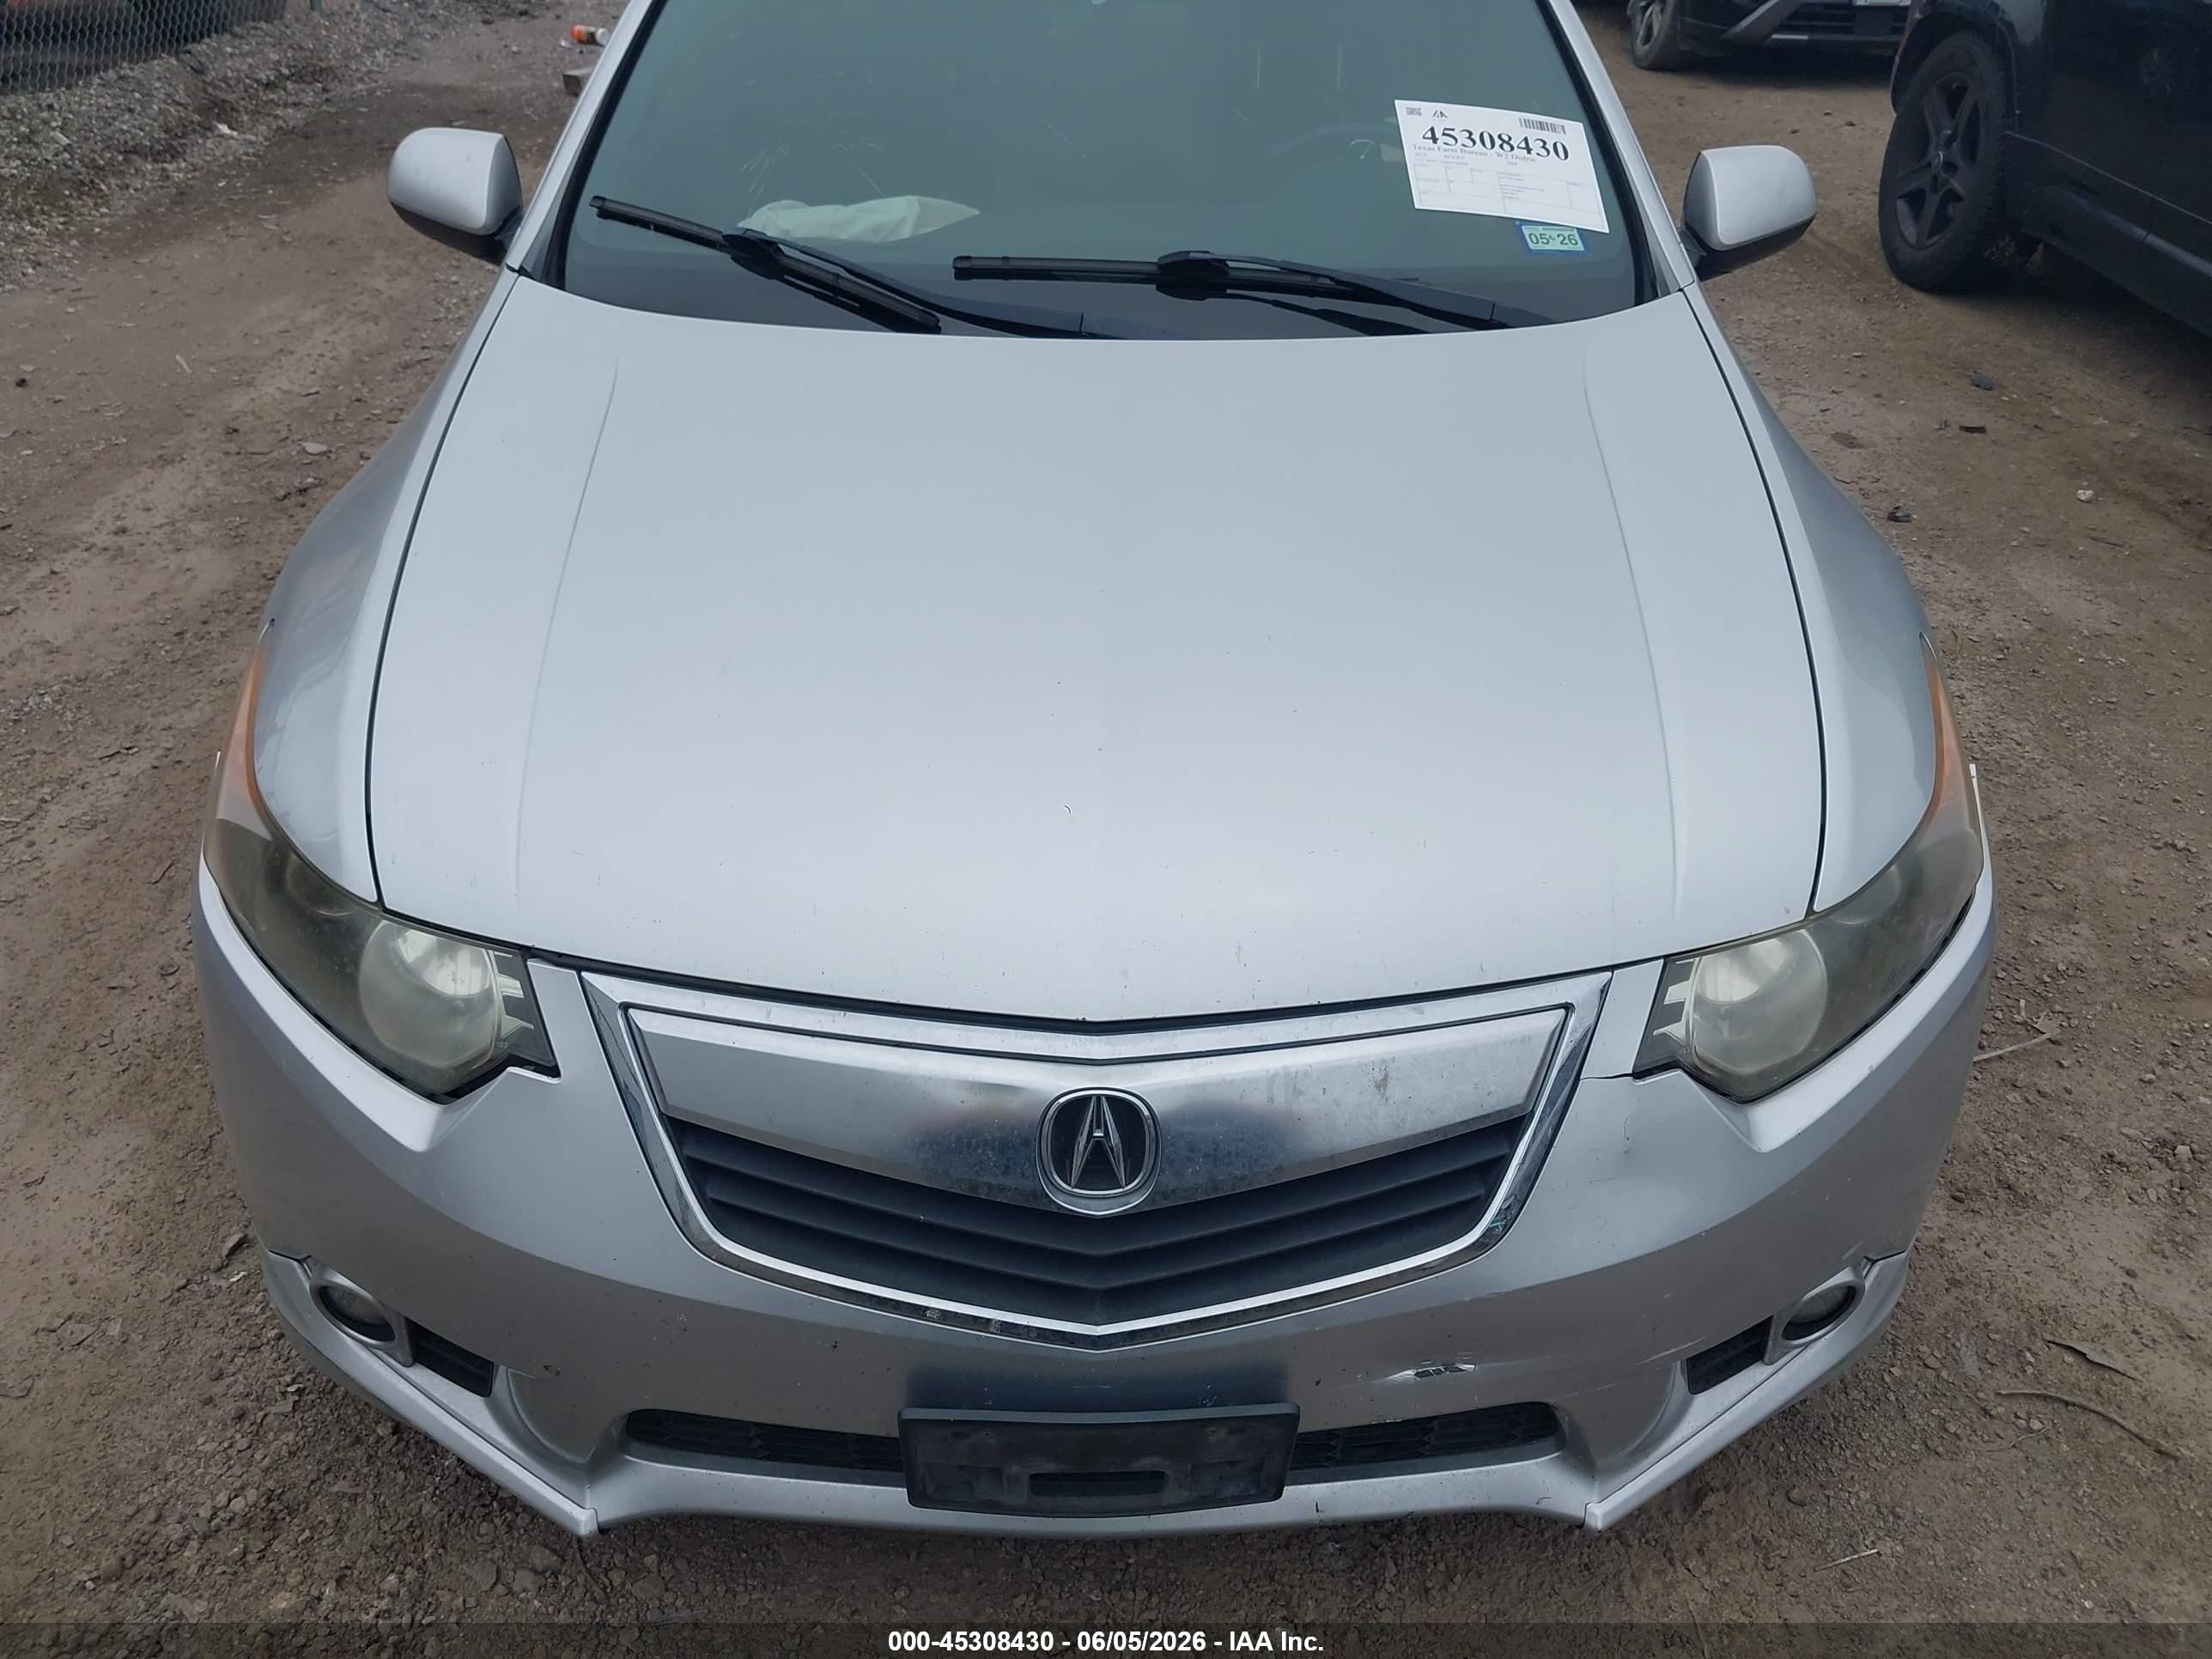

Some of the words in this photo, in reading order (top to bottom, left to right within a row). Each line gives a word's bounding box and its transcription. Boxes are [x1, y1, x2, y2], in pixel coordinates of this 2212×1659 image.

[1413, 143, 1436, 152] Texas
[1437, 145, 1458, 154] Farm
[1422, 125, 1570, 161] 45308430
[1528, 233, 1550, 245] 05
[1557, 234, 1578, 246] 26
